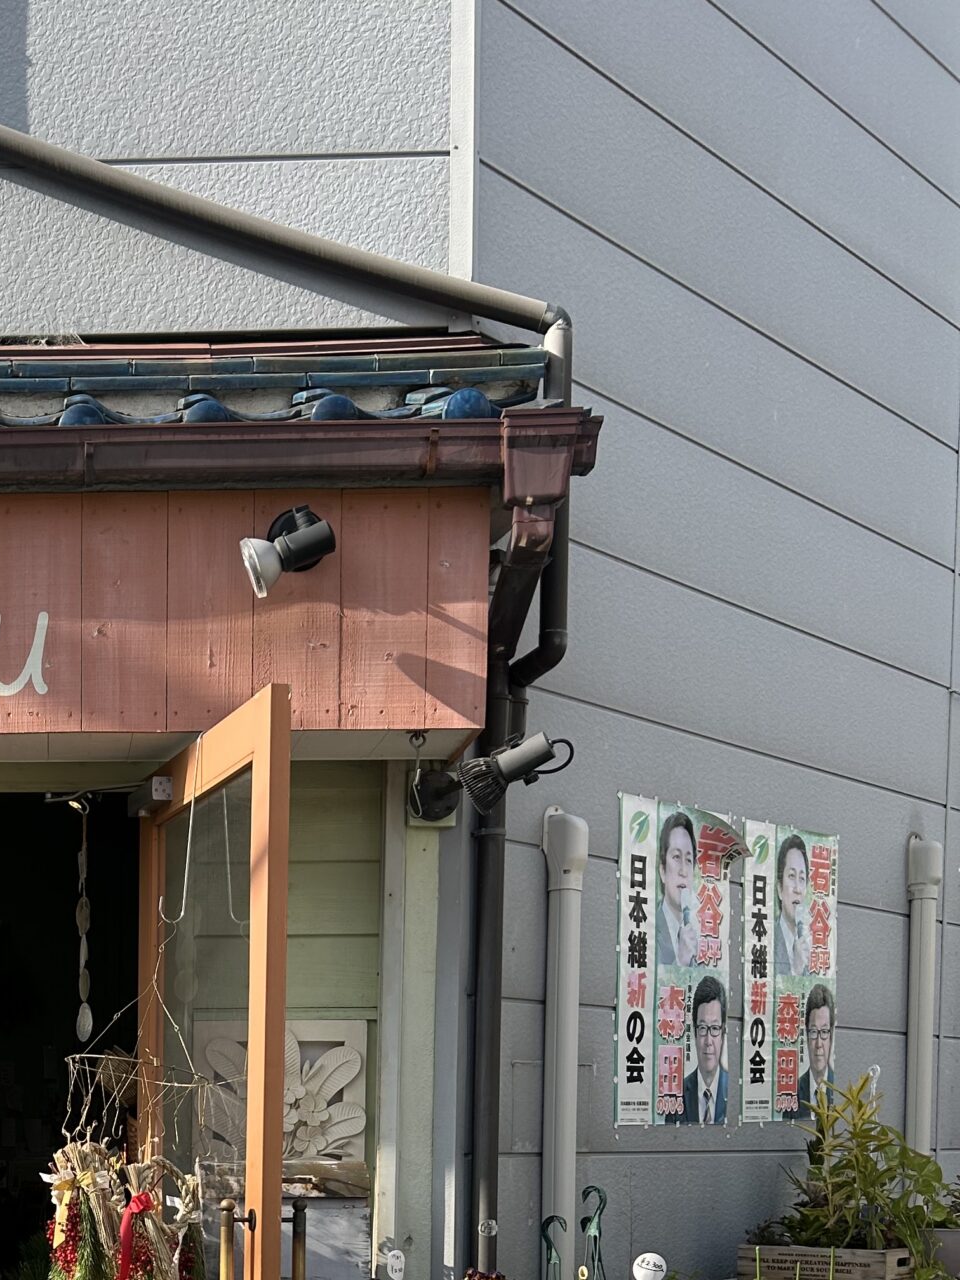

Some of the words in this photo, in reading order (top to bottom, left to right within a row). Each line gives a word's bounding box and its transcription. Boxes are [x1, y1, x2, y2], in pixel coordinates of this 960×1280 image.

[626, 853, 648, 1085] 日本維新の会
[749, 874, 768, 1084] 日本維新の会
